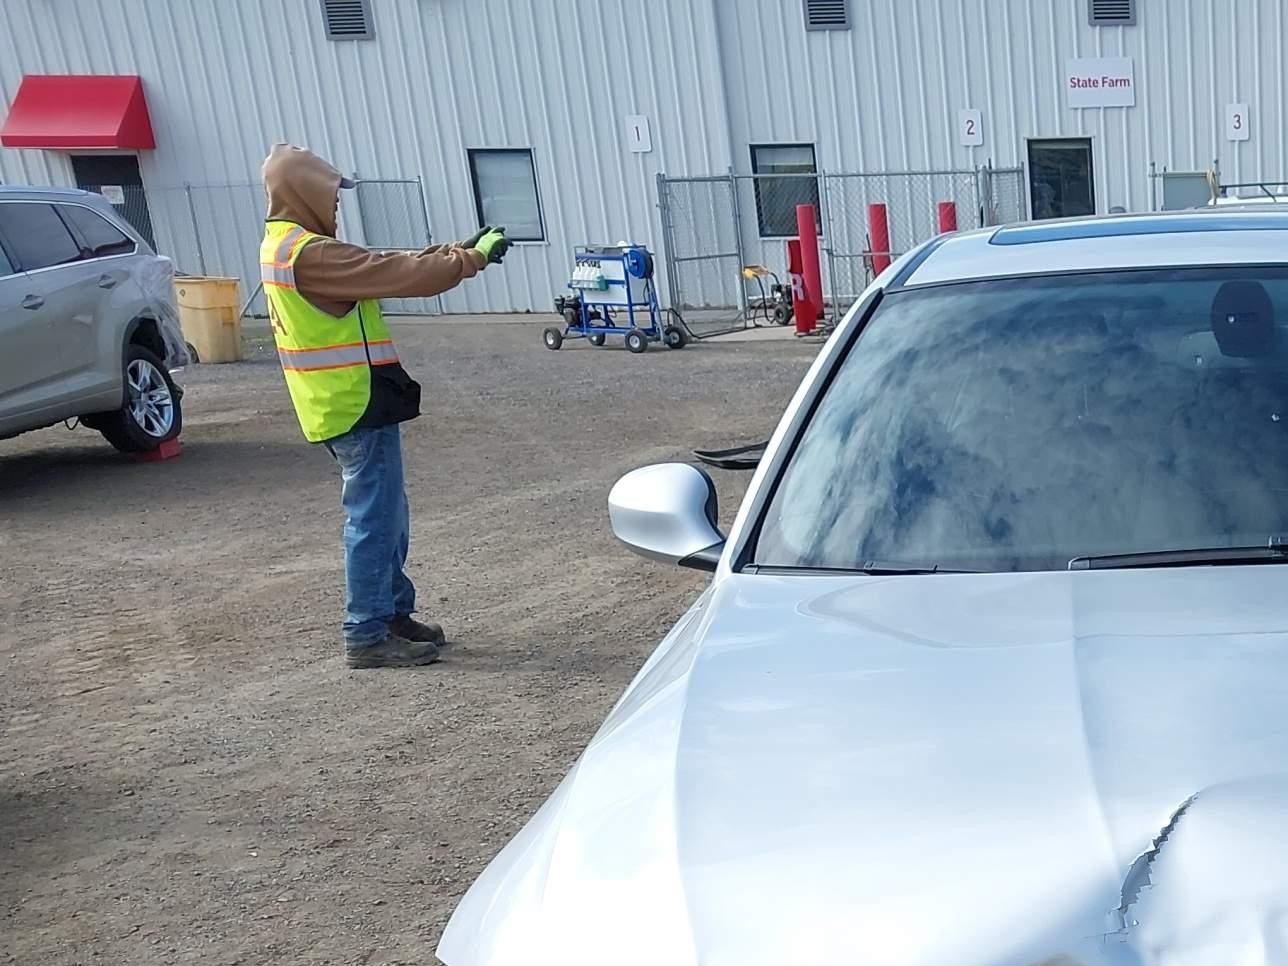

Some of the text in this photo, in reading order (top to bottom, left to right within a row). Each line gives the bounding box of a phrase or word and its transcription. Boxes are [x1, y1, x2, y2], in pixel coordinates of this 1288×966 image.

[1069, 76, 1131, 88] State Farm
[965, 120, 976, 136] 2
[1232, 114, 1242, 130] 3
[634, 126, 641, 142] 1
